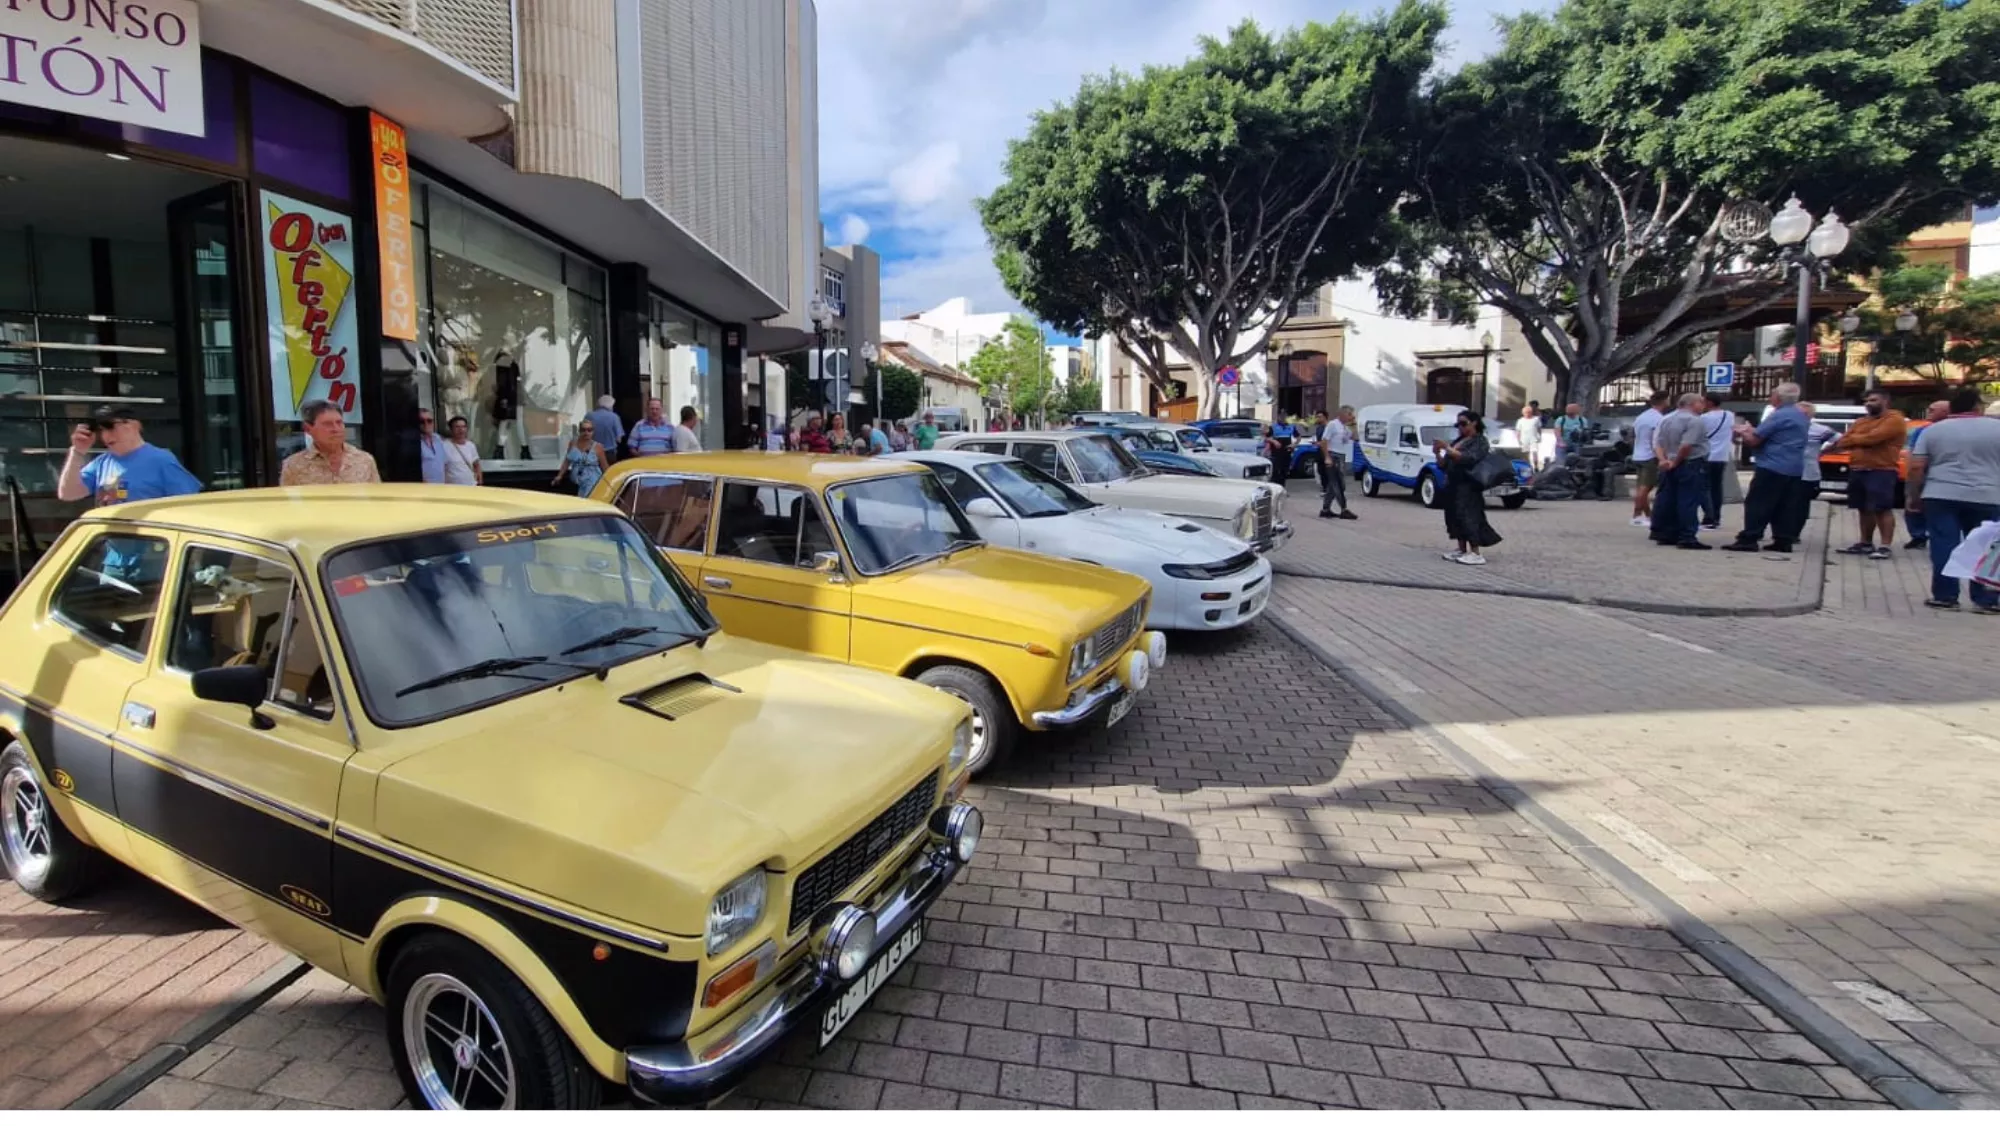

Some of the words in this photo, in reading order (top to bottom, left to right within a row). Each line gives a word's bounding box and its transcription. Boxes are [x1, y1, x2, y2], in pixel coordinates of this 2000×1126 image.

[0, 33, 170, 113] TÓN
[269, 212, 357, 413] Ofertón
[1712, 365, 1728, 383] P
[477, 523, 558, 542] Sport
